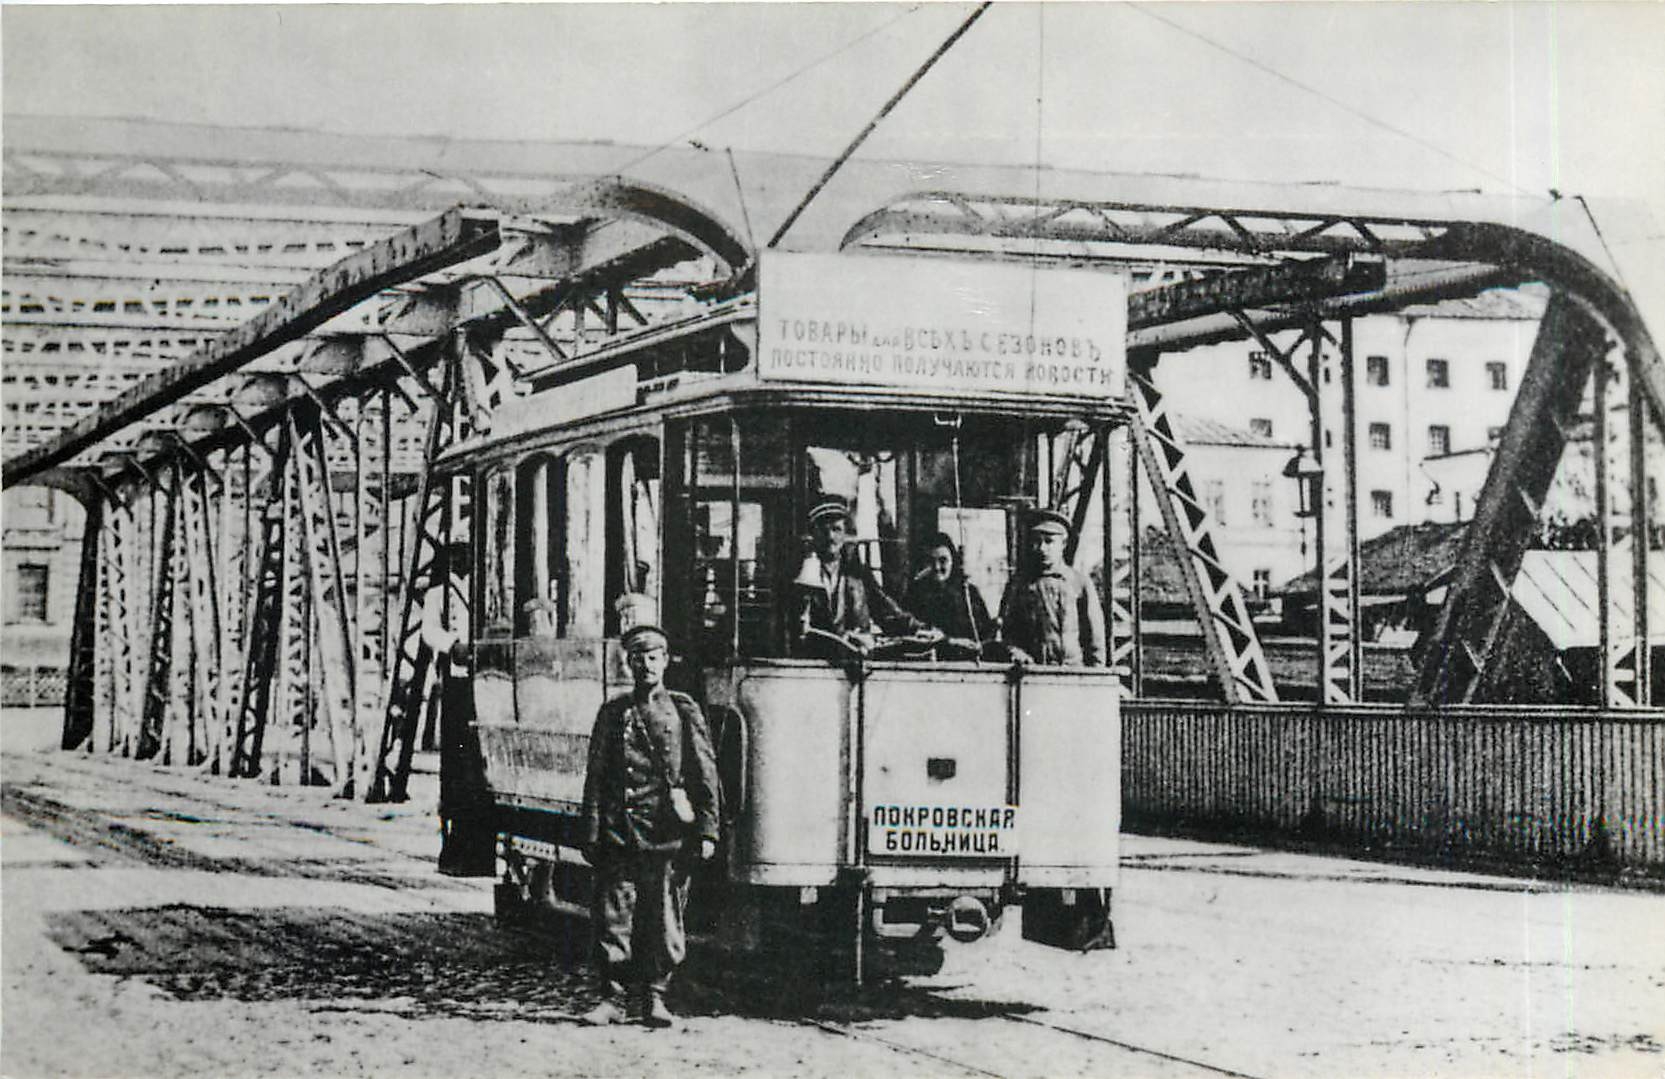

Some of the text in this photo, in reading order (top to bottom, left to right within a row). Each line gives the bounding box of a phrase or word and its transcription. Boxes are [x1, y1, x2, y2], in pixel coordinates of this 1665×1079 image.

[779, 319, 867, 345] ТОВАРЫ
[980, 331, 1102, 363] СЕЗОНОВЪ
[770, 348, 1113, 385] ПОСТОЯННО ПОЛУЧАЮТСЯ НОВОСТИ
[874, 805, 1015, 829] ПОКРОВСКАЯ
[886, 830, 999, 854] БОЛЬНИЦА
